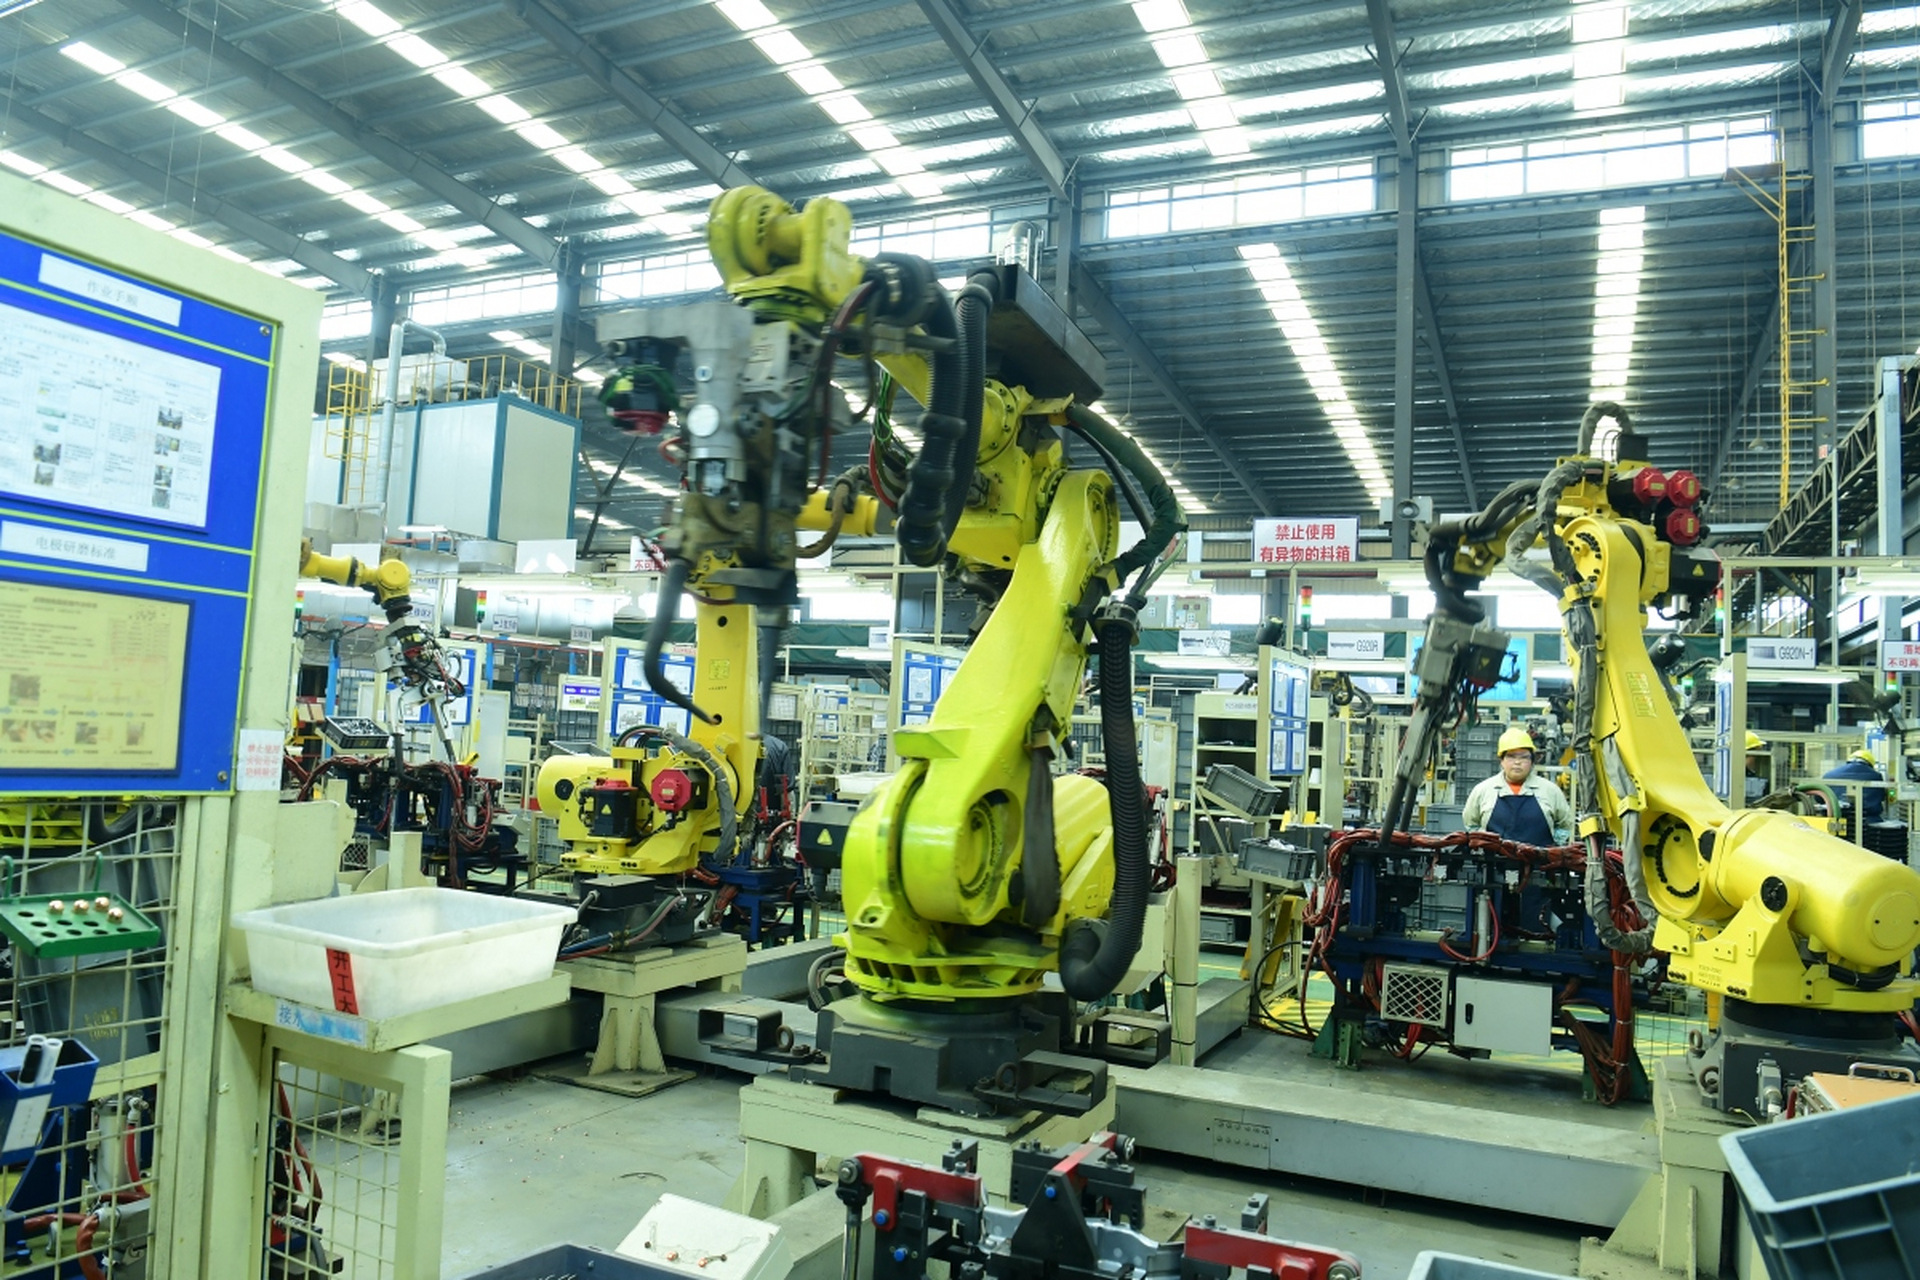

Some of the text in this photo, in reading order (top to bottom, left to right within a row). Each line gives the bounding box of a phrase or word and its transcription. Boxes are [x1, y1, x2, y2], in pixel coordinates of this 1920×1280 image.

[1275, 523, 1335, 540] 禁止使用
[35, 535, 117, 560] 电极研磨标准
[1260, 545, 1350, 562] 有异物的料箱
[1778, 646, 1814, 660] G920N-1
